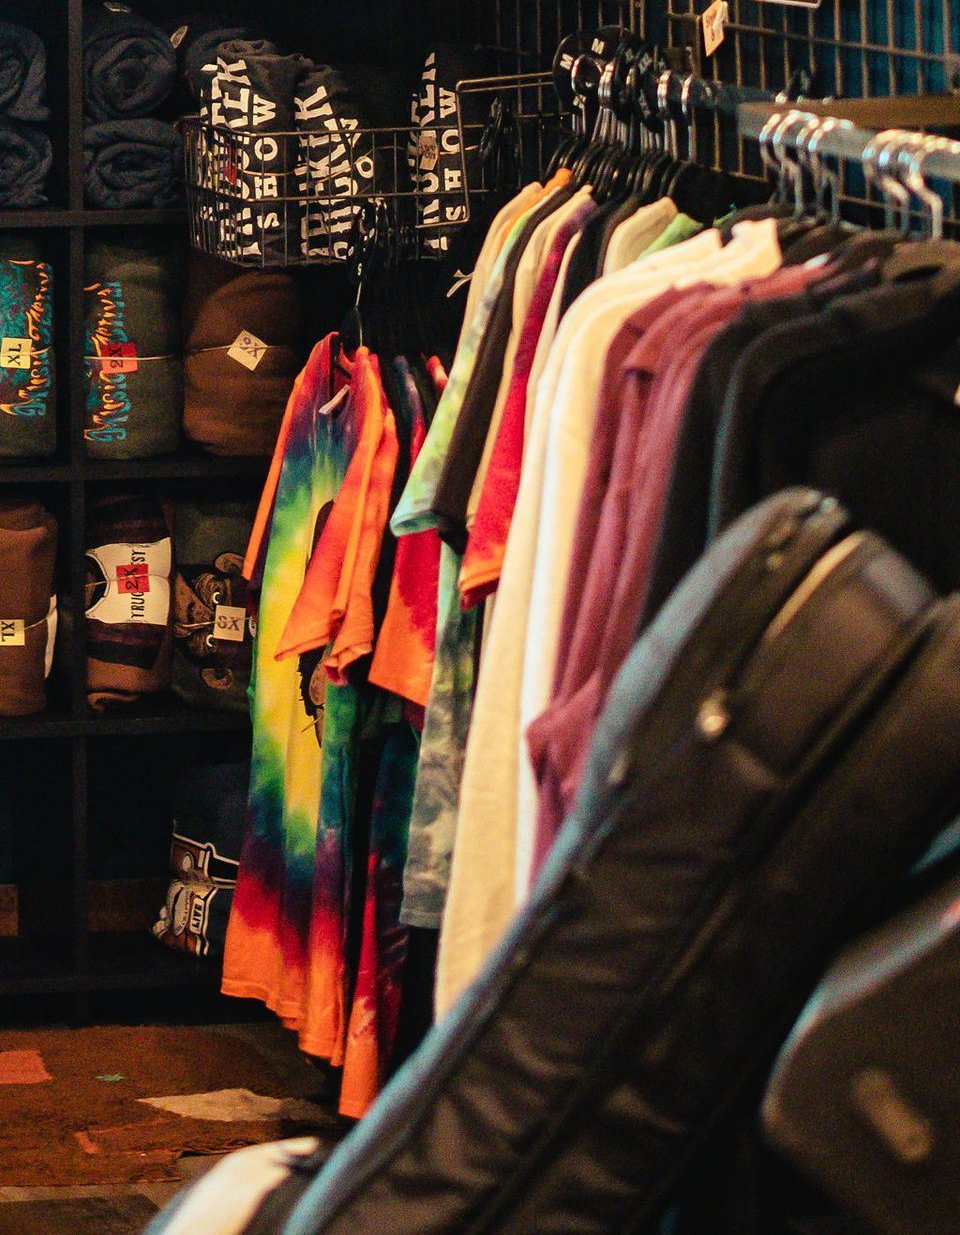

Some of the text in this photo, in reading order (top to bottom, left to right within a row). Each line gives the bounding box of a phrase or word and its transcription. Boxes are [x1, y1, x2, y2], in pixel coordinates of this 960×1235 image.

[253, 93, 280, 229] SHOW
[438, 87, 467, 222] SHOW
[7, 342, 23, 367] XL
[123, 567, 139, 591] 2X
[0, 621, 16, 643] XL
